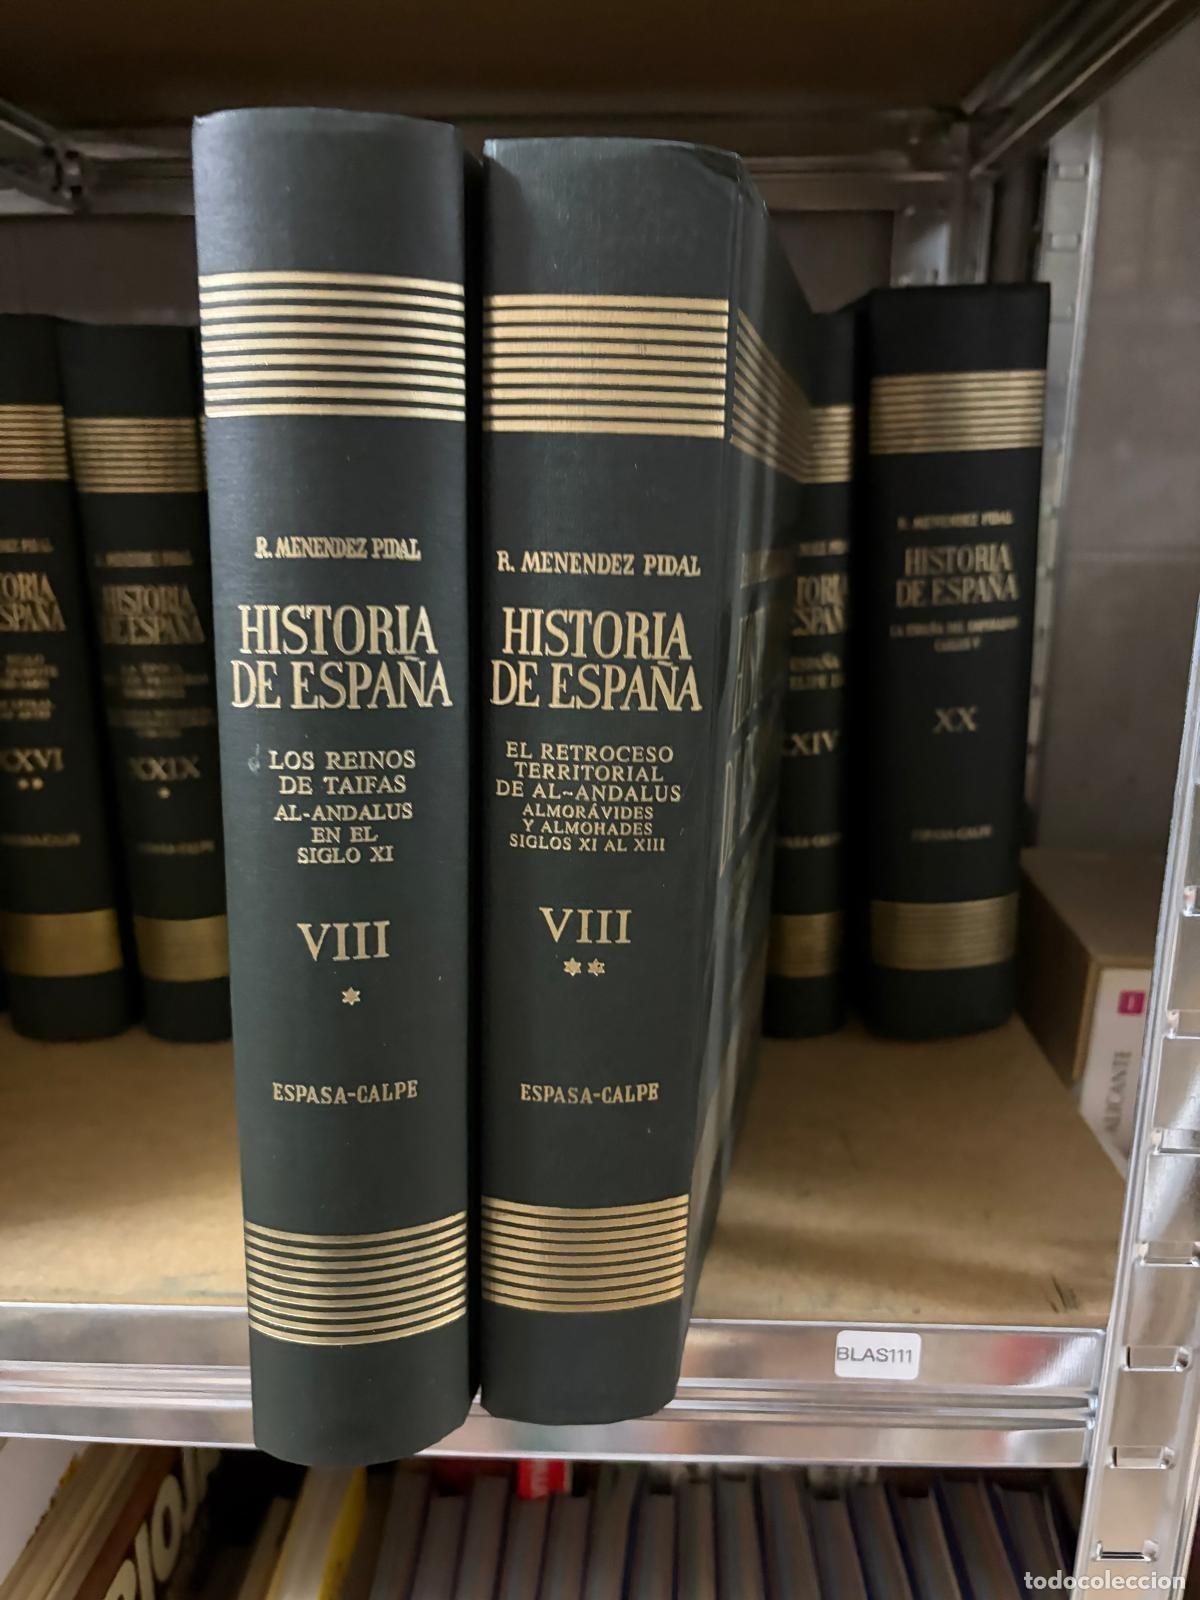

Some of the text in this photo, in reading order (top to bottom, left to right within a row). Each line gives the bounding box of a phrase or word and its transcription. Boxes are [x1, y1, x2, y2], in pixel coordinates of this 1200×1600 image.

[254, 536, 422, 561] R. MENENDEZ PIDAL
[905, 543, 1013, 576] HISTORIA
[496, 550, 701, 577] R. MENENDEZ PIDAL
[238, 604, 439, 656] HISTORIA
[502, 607, 692, 661] HISTORIA
[230, 660, 281, 709] DE
[290, 654, 453, 710] ESPAÑA
[490, 659, 703, 712] DE ESPAÑA
[268, 750, 416, 771] LOS REINOS
[505, 740, 674, 764] EL RETROCESO
[514, 761, 664, 783] TERRITORIAL
[279, 774, 407, 796] DE TAIFAS
[496, 778, 682, 803] DE AL-ANDALUS
[273, 801, 414, 823] AL-ANDALUS
[522, 798, 654, 821] ALMORÁVIDES
[311, 826, 379, 844] EN EL
[522, 818, 653, 837] Y ALMOHADES
[509, 833, 666, 852] SIGLOS XI AL XIII
[297, 845, 395, 865] SIGLO XI
[538, 906, 632, 944] VIII
[296, 920, 391, 962] VIII
[272, 1079, 419, 1105] ESPASA-CALPE
[520, 1081, 660, 1105] ESPASA-CALPE
[836, 1346, 913, 1364] BLAS111
